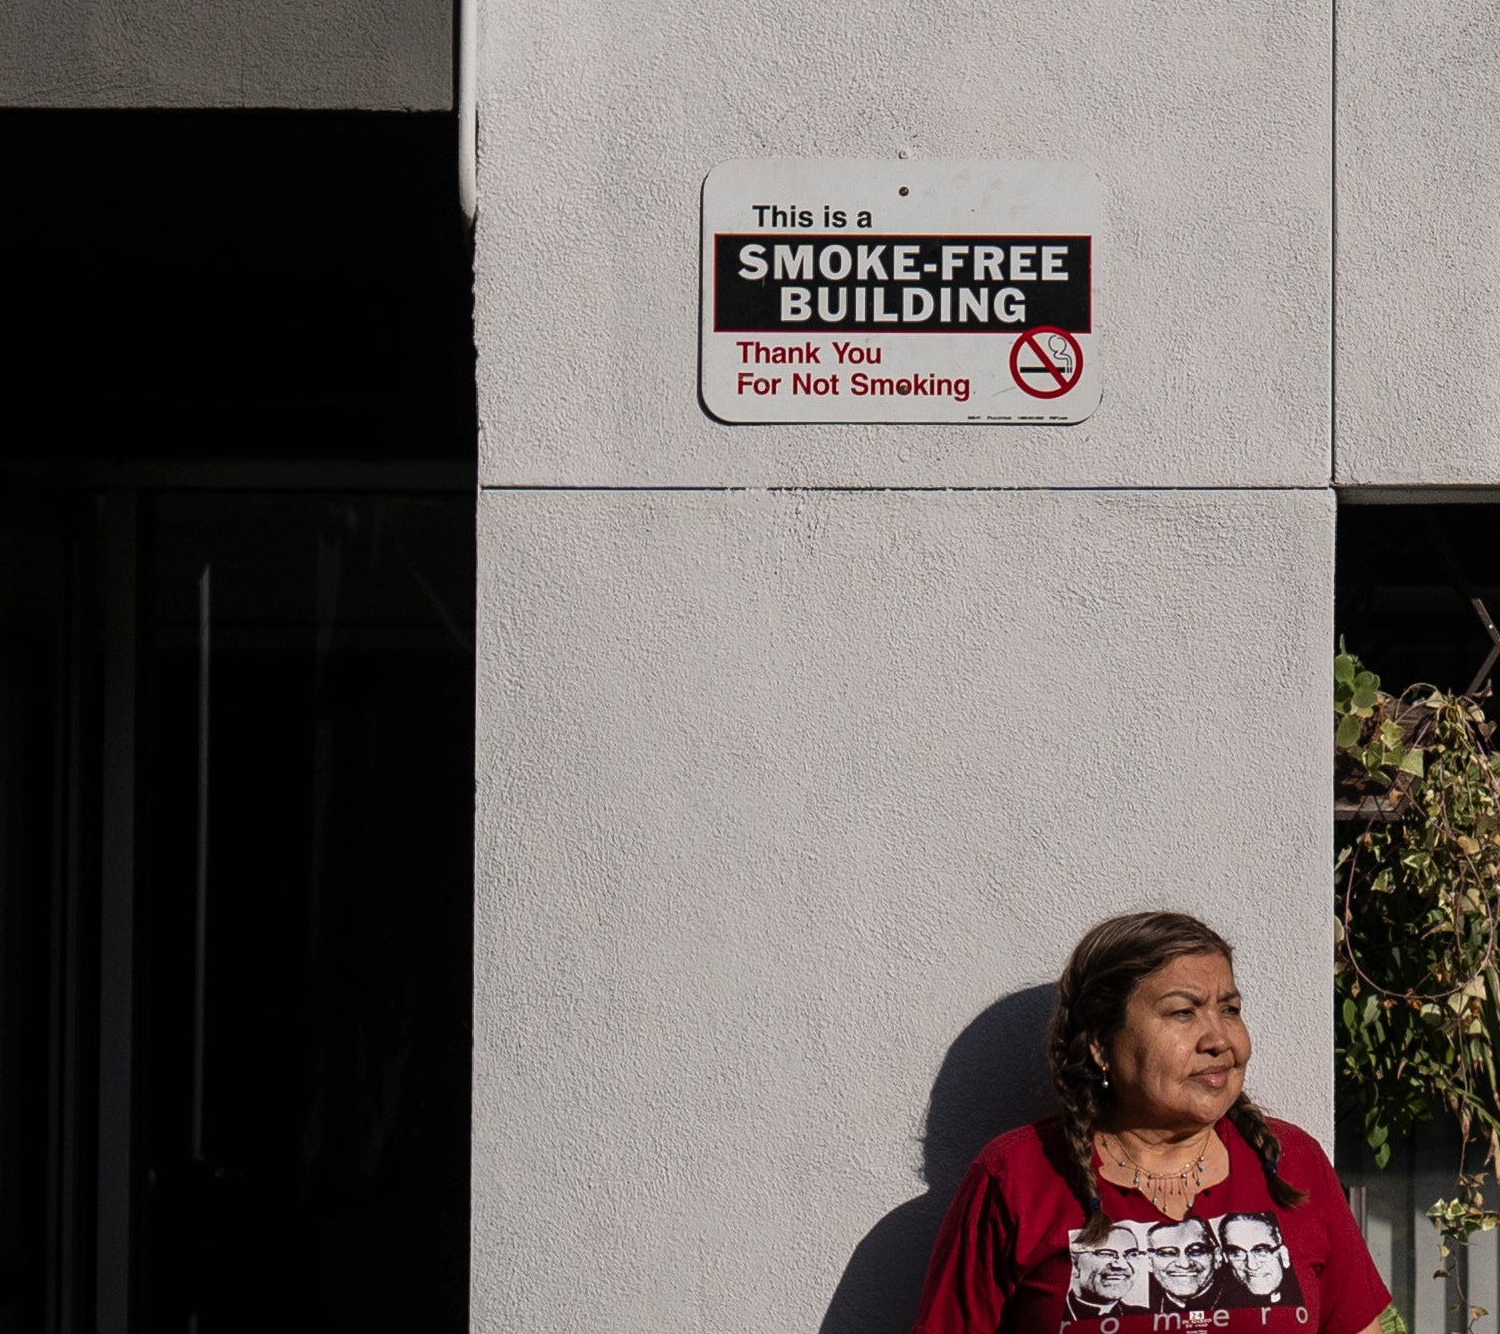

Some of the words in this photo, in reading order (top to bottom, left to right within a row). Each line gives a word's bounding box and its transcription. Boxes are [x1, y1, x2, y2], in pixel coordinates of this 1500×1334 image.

[752, 204, 814, 228] This
[823, 204, 848, 228] is
[856, 210, 873, 229] a
[737, 243, 1069, 281] SMOKE-FREE
[780, 286, 1026, 323] BUILDING
[736, 341, 821, 364] Thank
[832, 341, 882, 365] You
[737, 372, 782, 396] For
[792, 372, 840, 396] Not
[850, 372, 970, 402] Smoking
